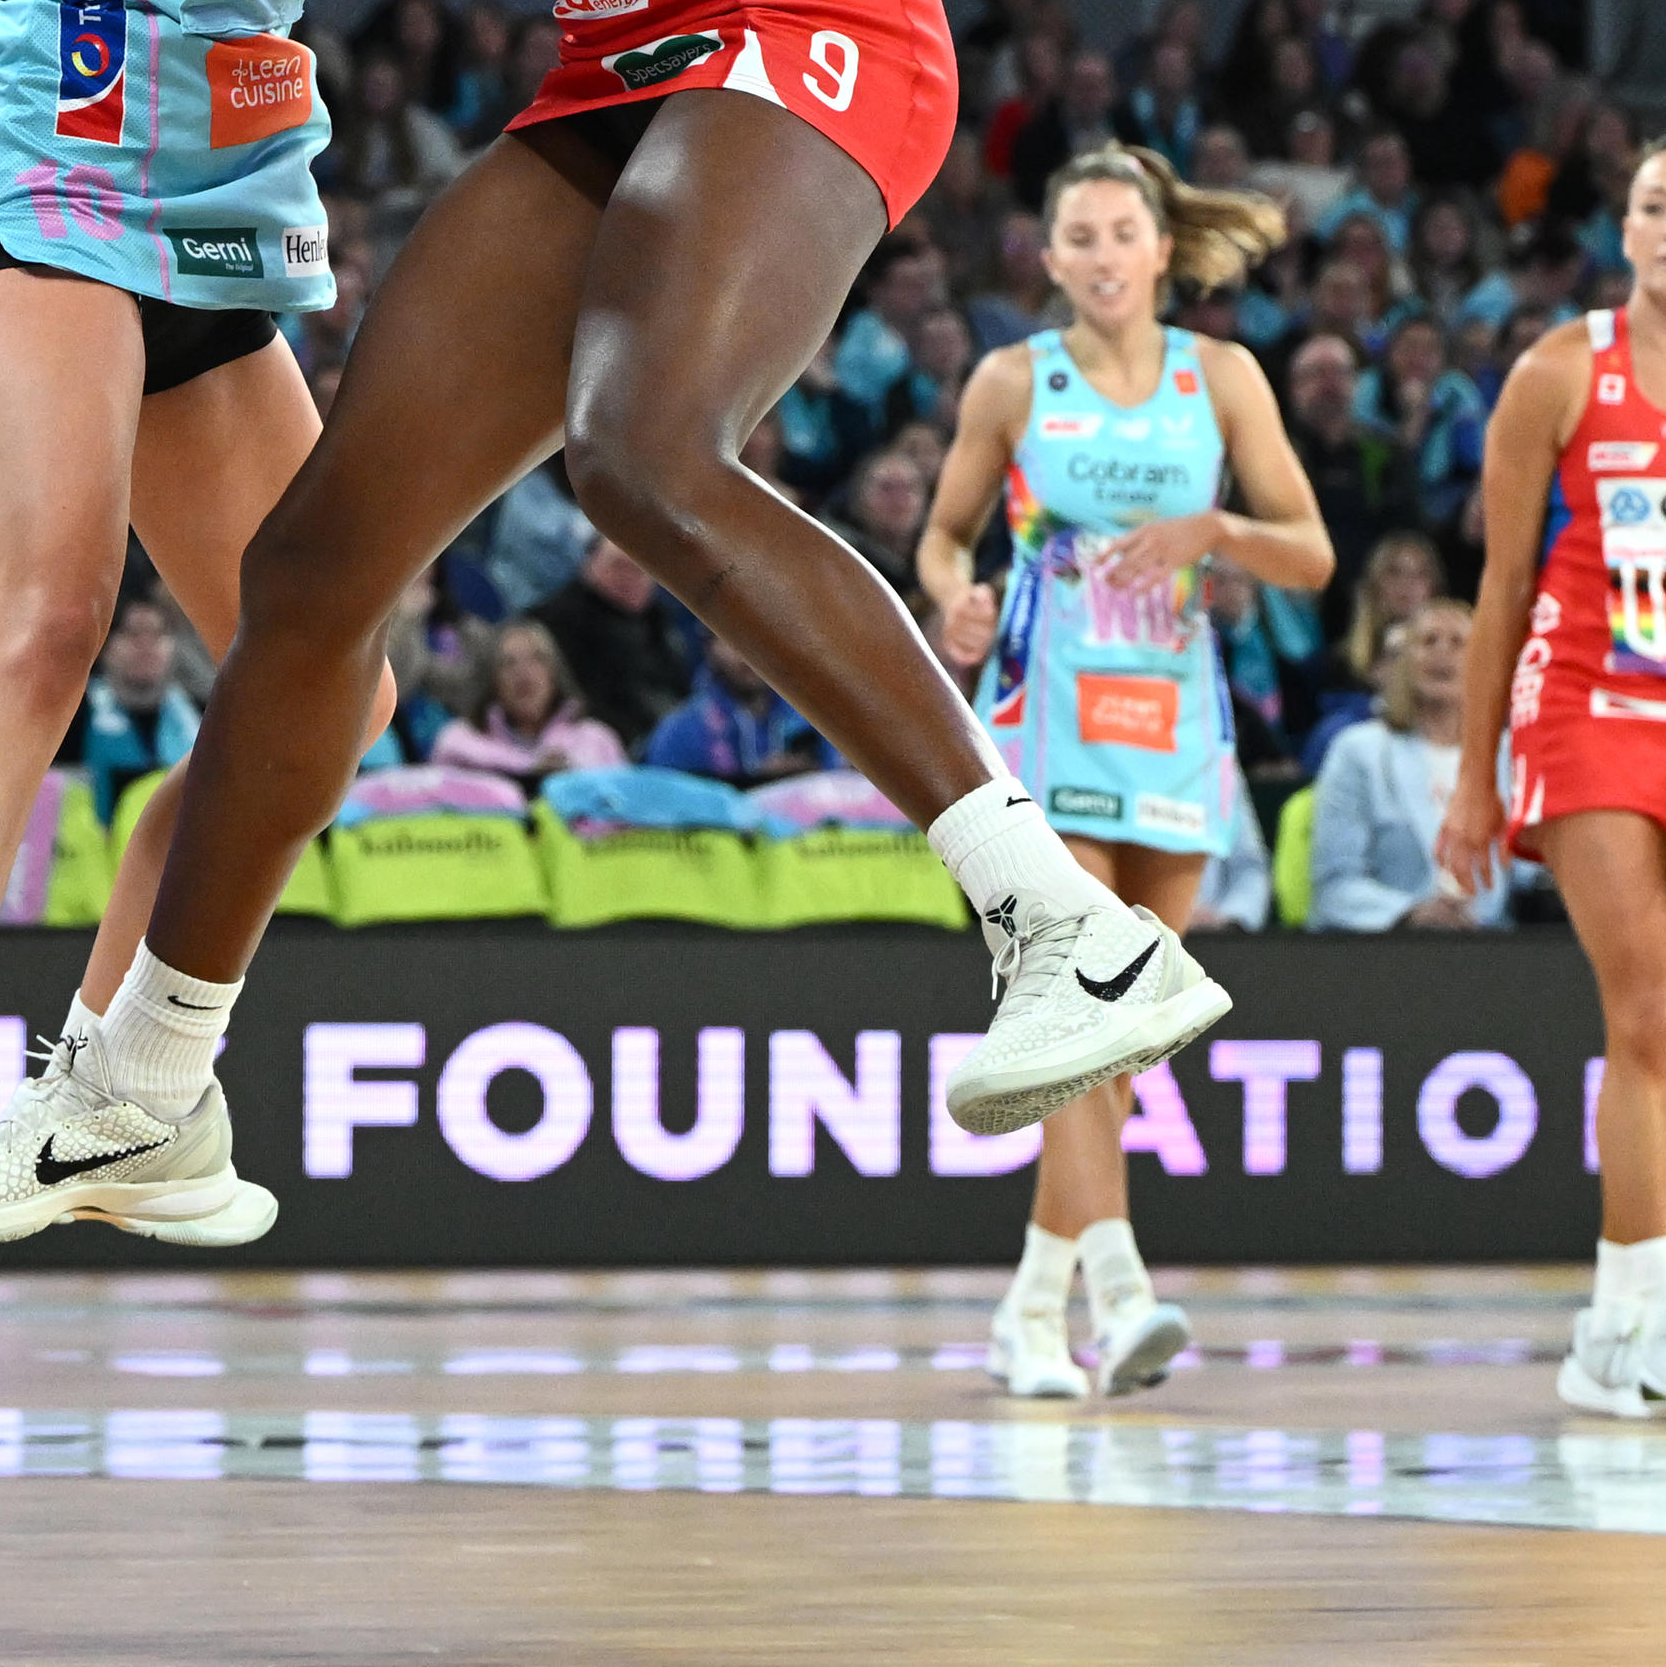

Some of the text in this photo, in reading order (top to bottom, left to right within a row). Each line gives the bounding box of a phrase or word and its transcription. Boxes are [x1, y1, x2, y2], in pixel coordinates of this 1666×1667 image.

[248, 55, 301, 80] Lean
[626, 42, 711, 84] Specsavers
[802, 30, 859, 112] 9
[15, 158, 126, 241] 10
[182, 237, 253, 262] Gerni
[1067, 452, 1190, 484] Cobram
[304, 1020, 1601, 1184] FOUNDTIO
